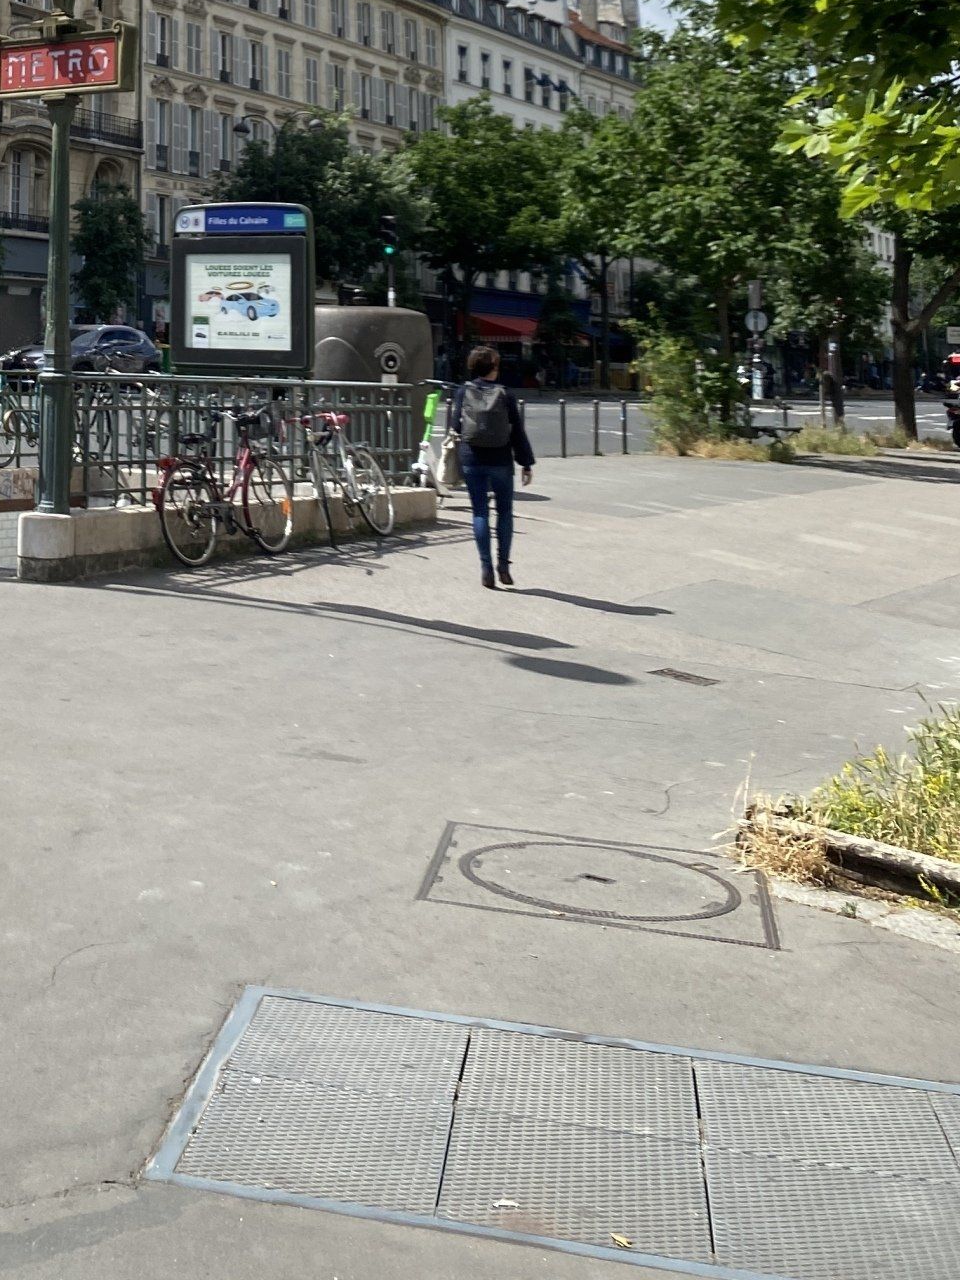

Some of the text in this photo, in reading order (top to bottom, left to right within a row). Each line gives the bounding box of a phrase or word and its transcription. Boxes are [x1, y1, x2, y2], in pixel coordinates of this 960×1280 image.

[7, 45, 110, 84] METRO
[207, 215, 268, 226] Filles du Calvaire
